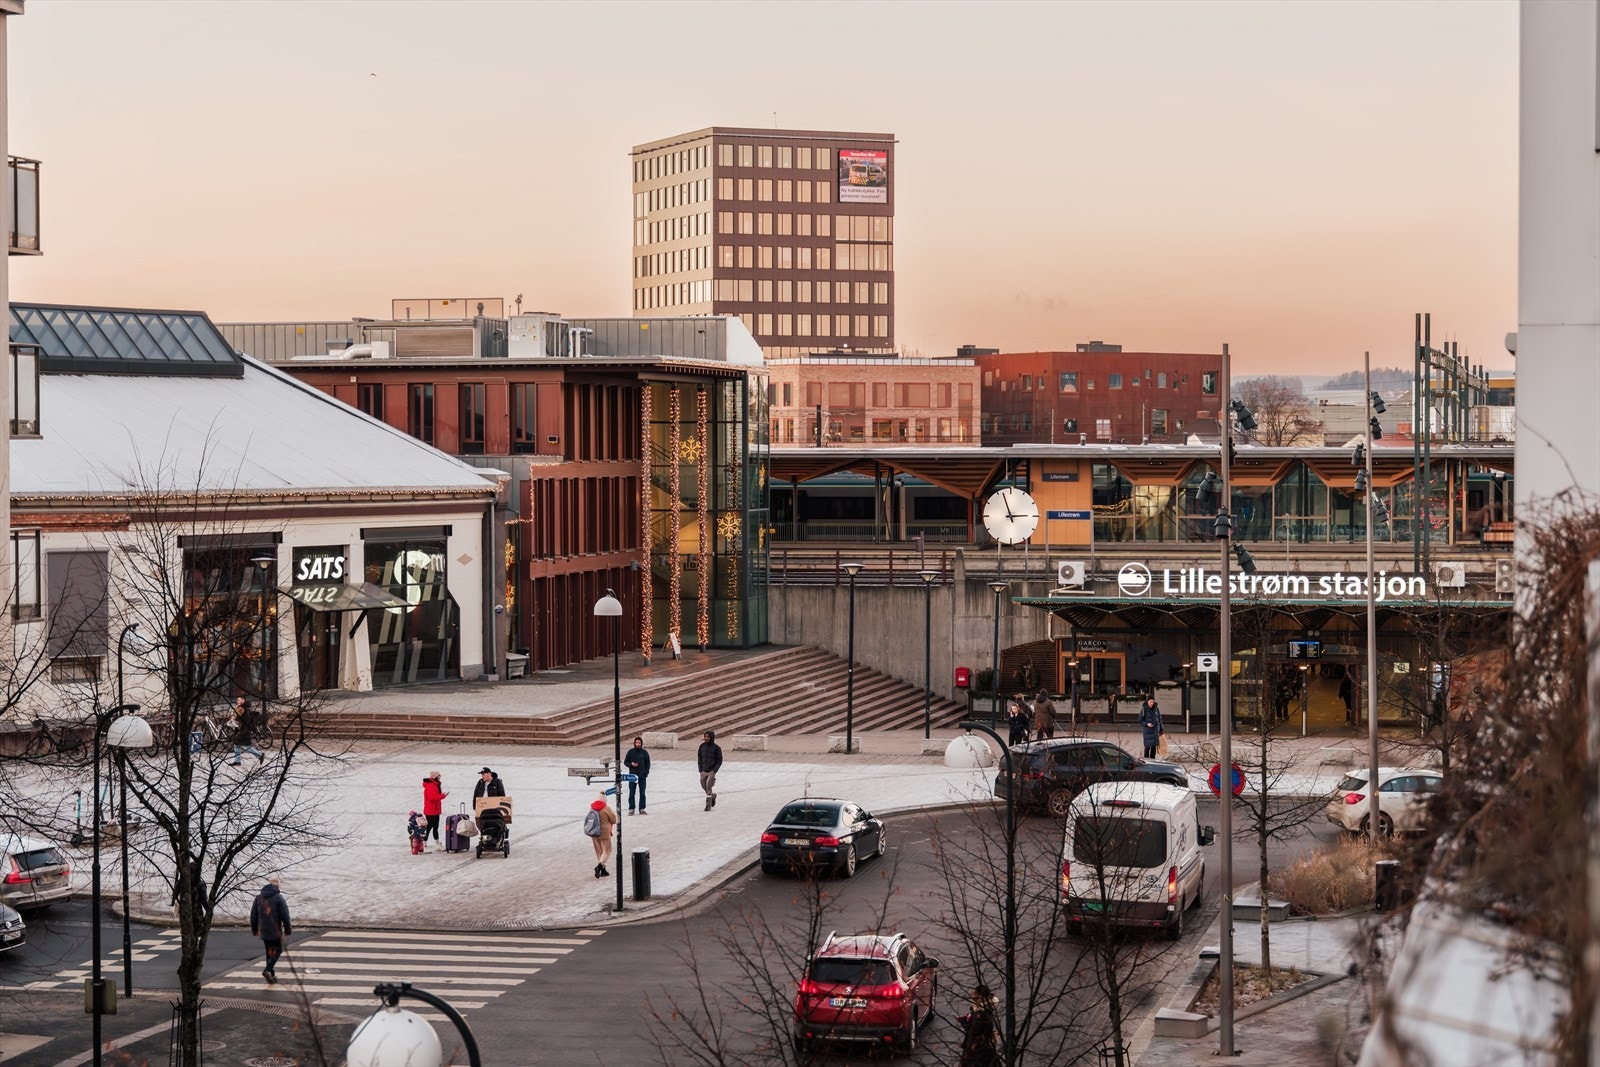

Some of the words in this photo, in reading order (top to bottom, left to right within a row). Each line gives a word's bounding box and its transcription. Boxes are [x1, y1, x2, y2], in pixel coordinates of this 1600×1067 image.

[297, 556, 345, 581] SATS
[1163, 568, 1310, 595] Lillestrøm
[1318, 570, 1426, 603] stasjon
